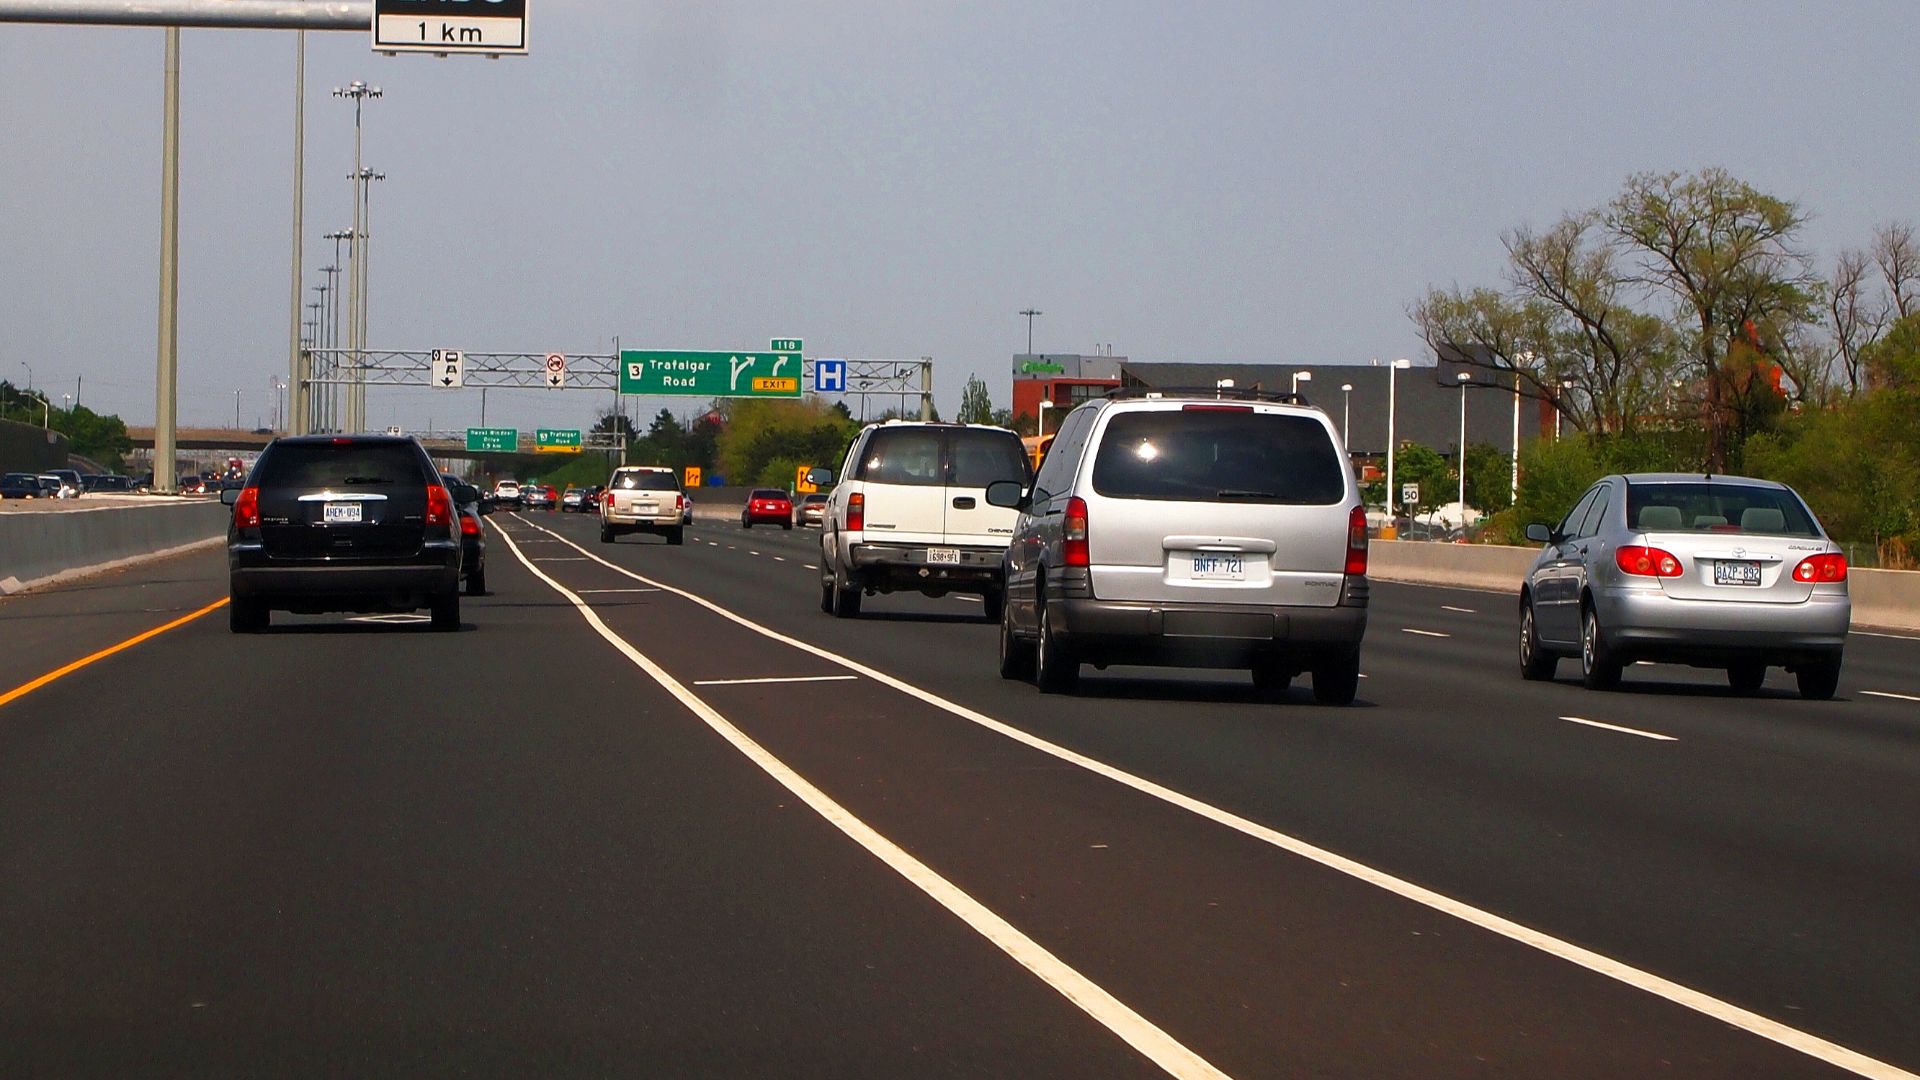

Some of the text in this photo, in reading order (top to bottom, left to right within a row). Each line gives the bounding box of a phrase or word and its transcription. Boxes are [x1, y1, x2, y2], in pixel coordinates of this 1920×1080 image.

[418, 22, 482, 42] 1 km
[777, 341, 795, 350] 118
[631, 366, 640, 376] 3
[650, 359, 711, 373] Trafalgar
[820, 363, 842, 389] H
[663, 376, 696, 387] Road
[763, 380, 787, 389] EXIT
[1405, 491, 1417, 500] 50
